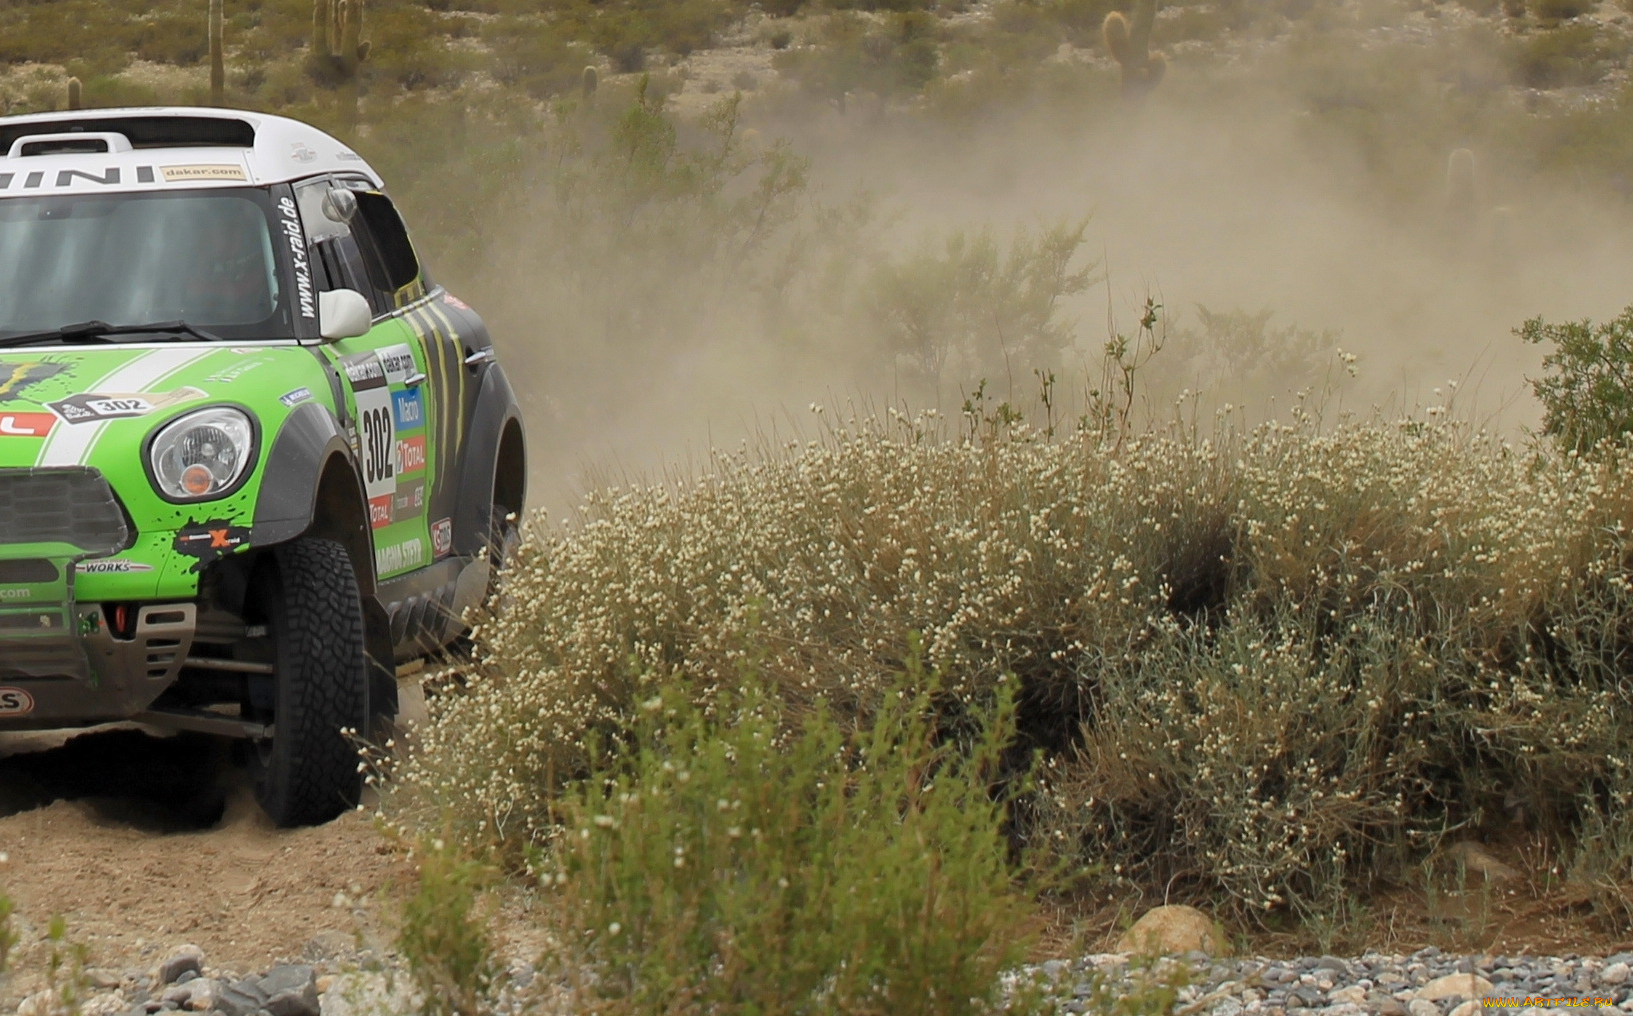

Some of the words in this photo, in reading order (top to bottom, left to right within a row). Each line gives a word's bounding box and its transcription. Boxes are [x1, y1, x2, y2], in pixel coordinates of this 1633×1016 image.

[166, 168, 241, 177] dakar.com
[277, 197, 315, 319] www.x-raid.de
[98, 399, 147, 412] 302
[363, 406, 393, 483] 302
[403, 442, 425, 467] TOTAL
[369, 503, 389, 523] TOTAL
[86, 563, 130, 572] WORKS
